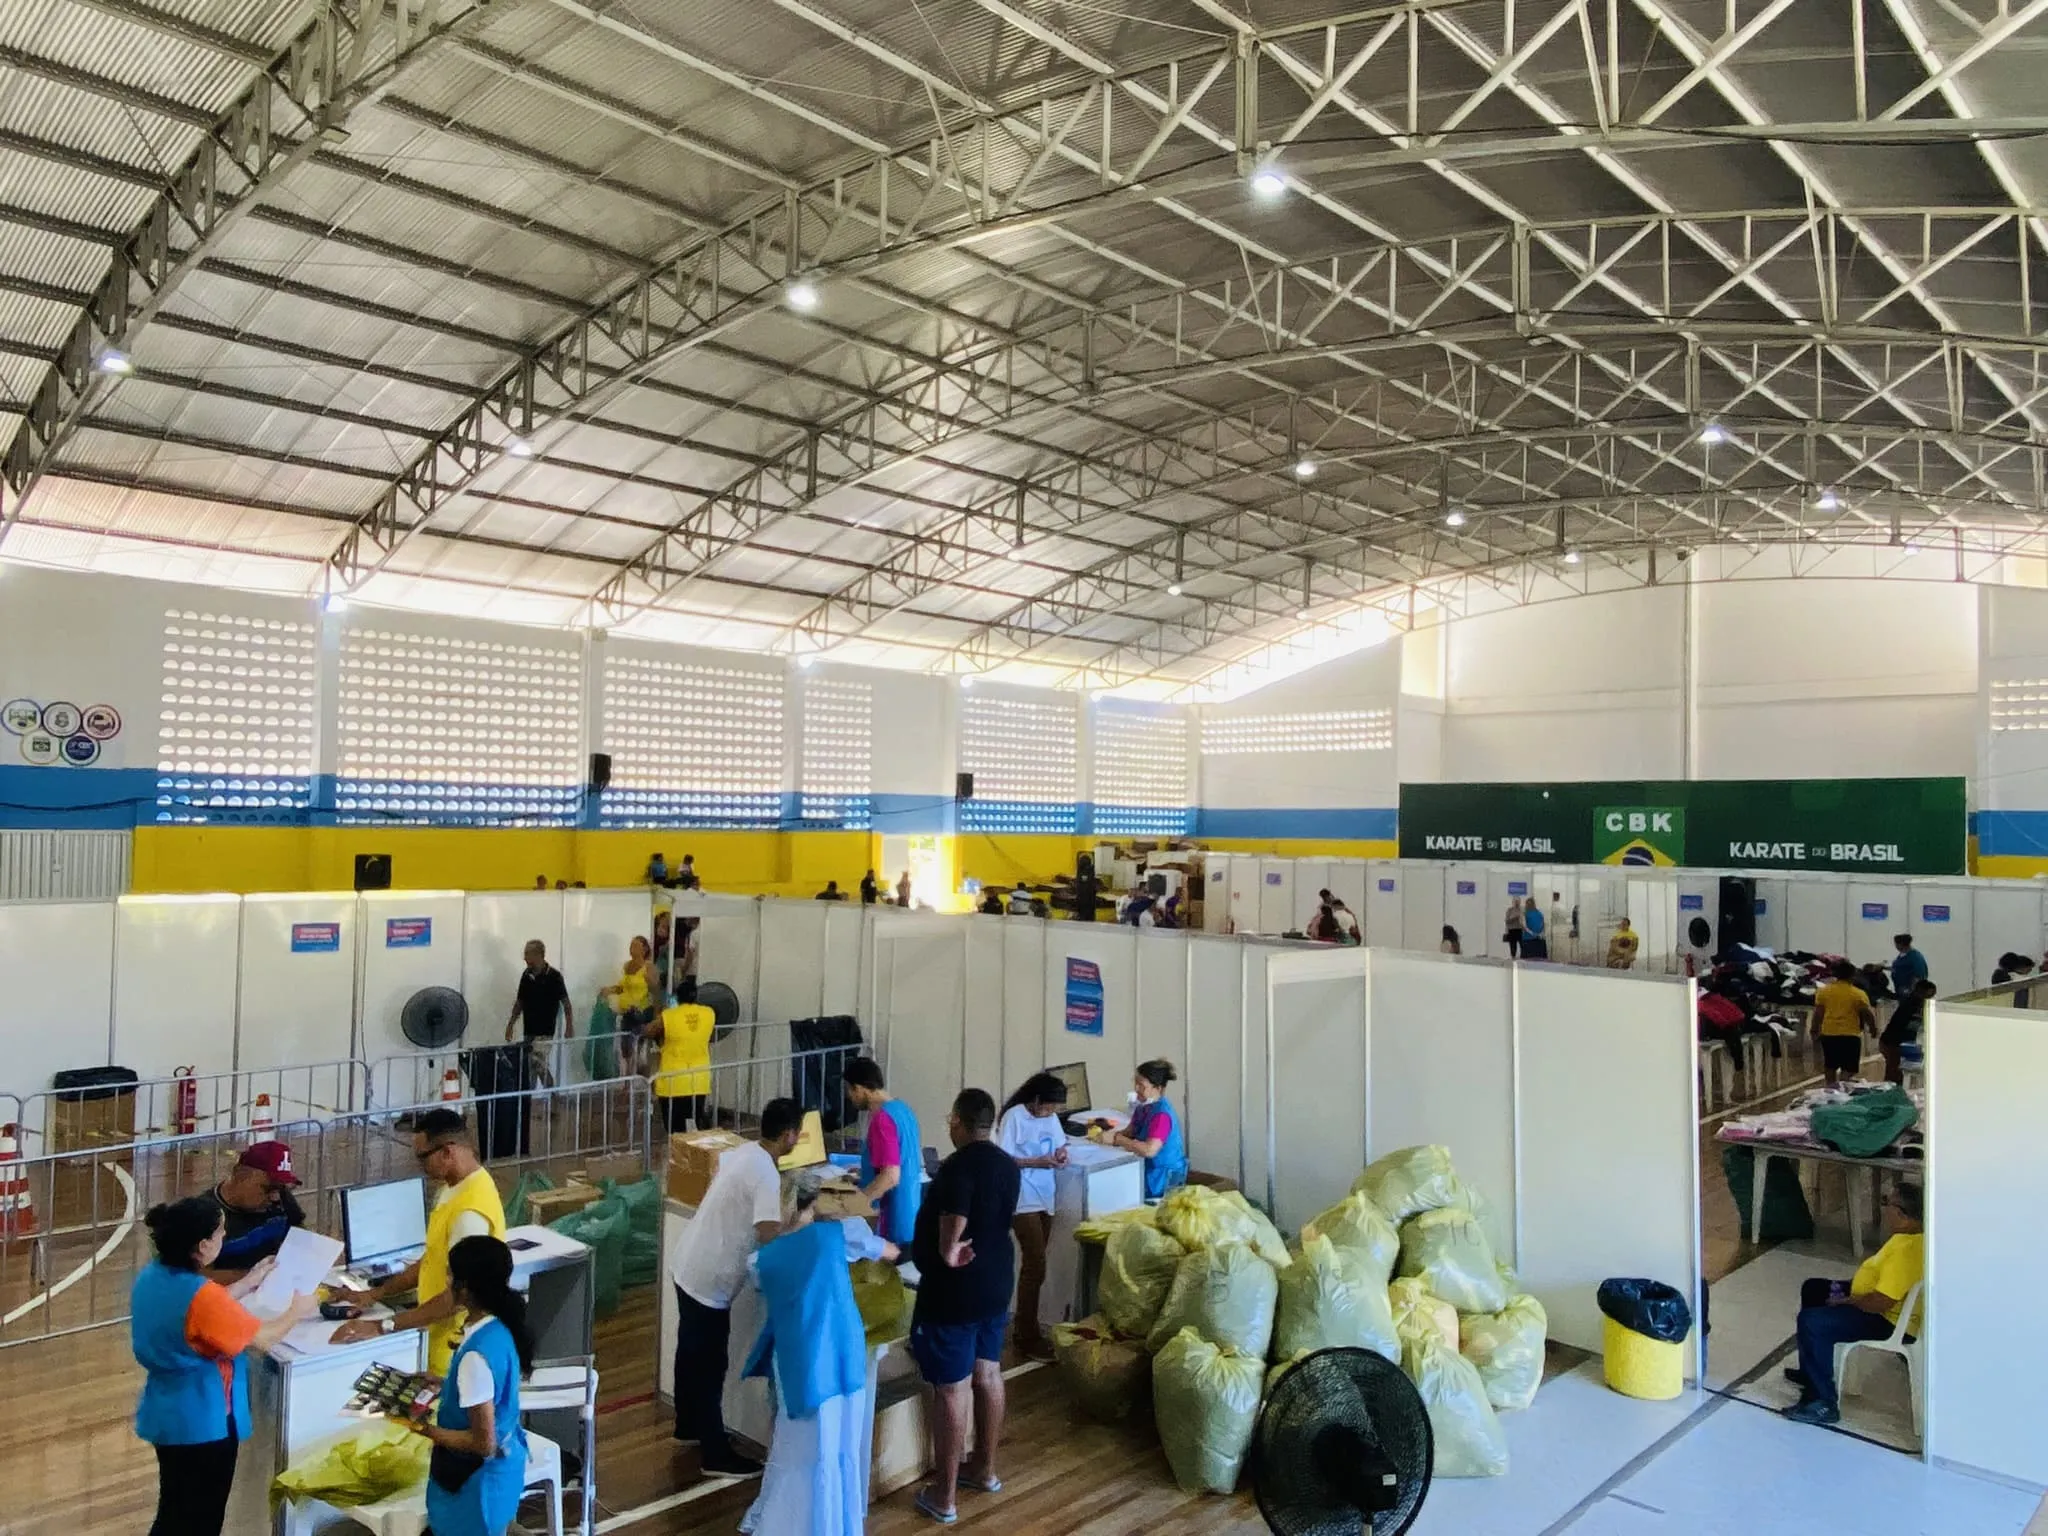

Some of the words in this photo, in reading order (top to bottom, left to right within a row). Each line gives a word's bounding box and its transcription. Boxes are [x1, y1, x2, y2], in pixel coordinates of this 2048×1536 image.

[1605, 812, 1673, 832] CBK
[1425, 835, 1483, 851] KARATE
[1500, 837, 1556, 853] BRASIL
[1729, 842, 1806, 859] KARATE
[1830, 843, 1905, 861] BRASIL
